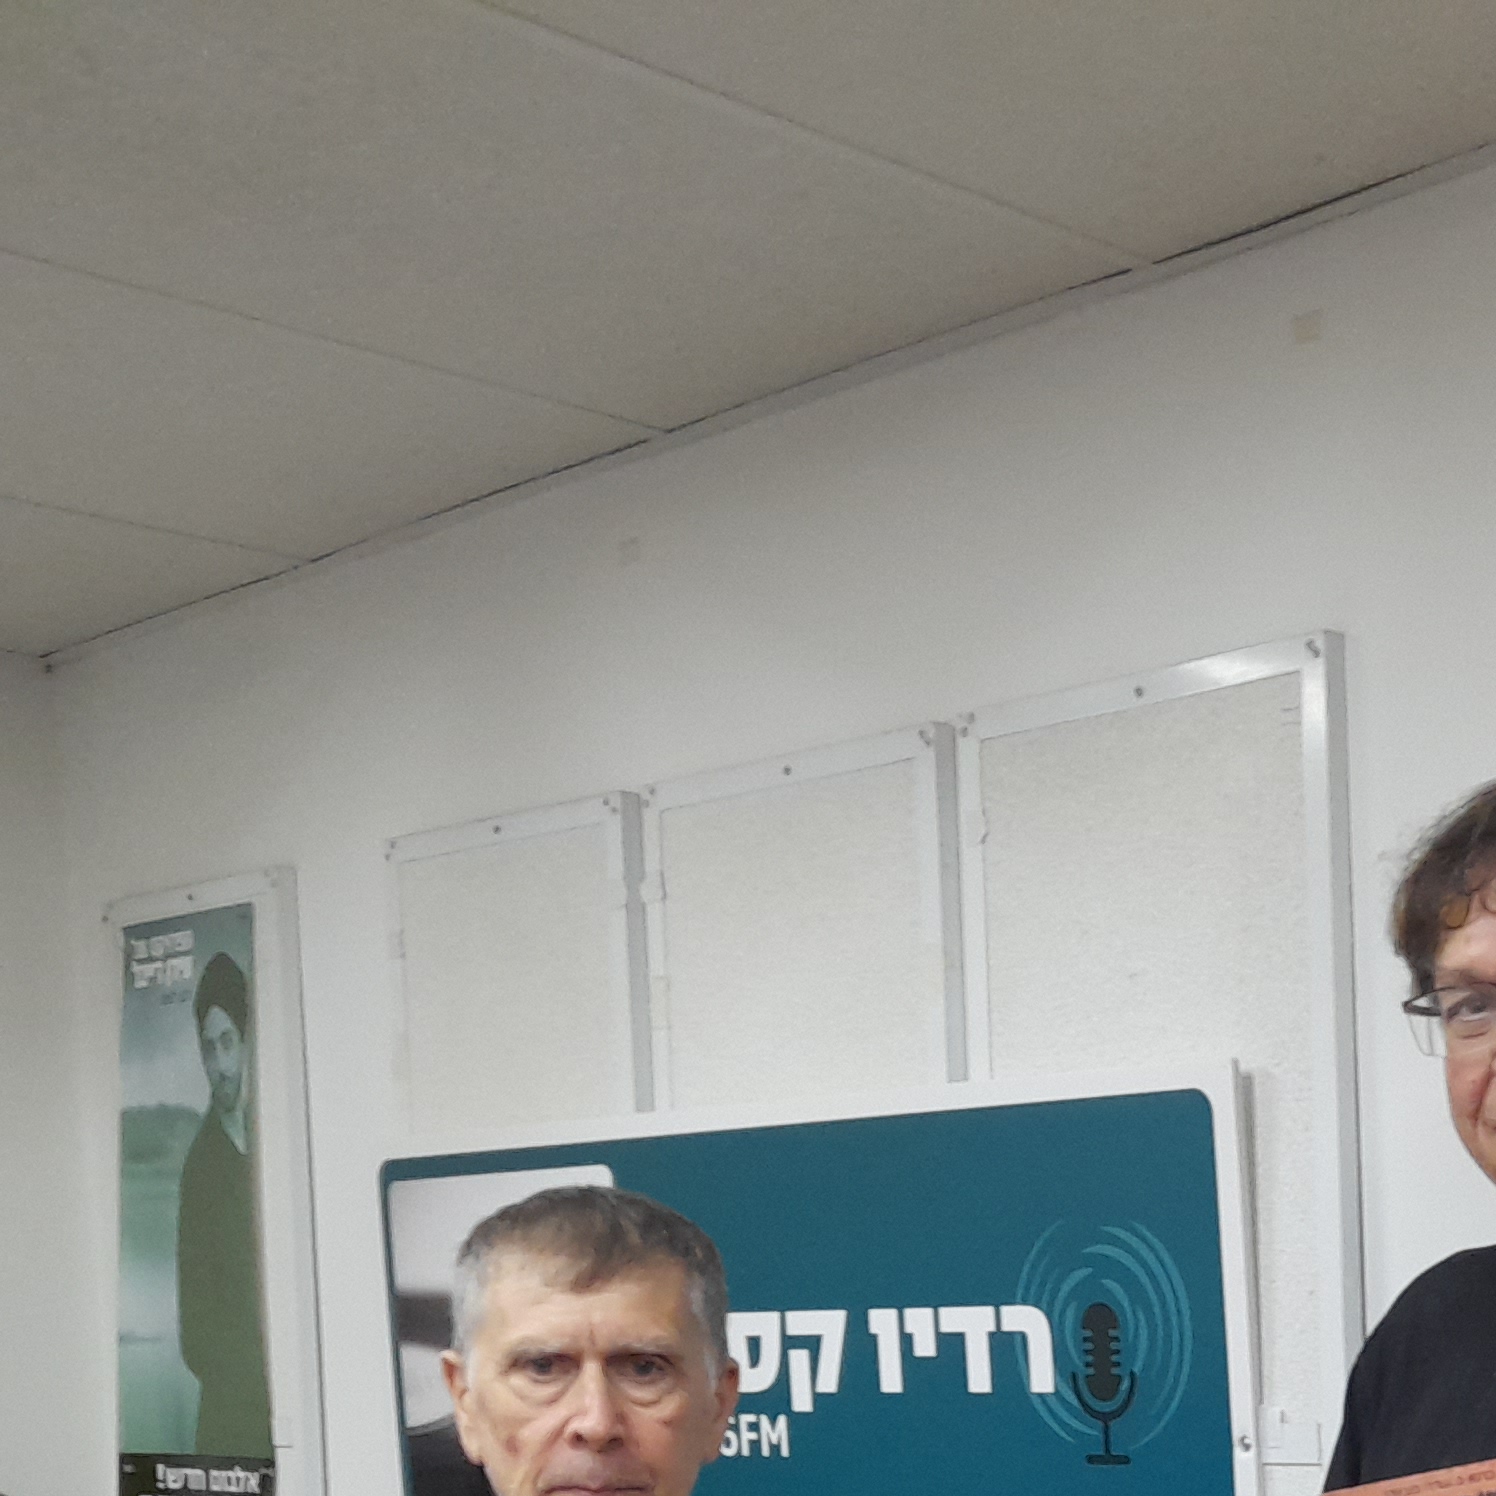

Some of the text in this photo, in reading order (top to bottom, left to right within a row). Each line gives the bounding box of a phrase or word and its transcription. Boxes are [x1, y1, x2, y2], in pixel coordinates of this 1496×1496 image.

[725, 1304, 1056, 1413] רדיו קס
[718, 1413, 790, 1458] 6FM
